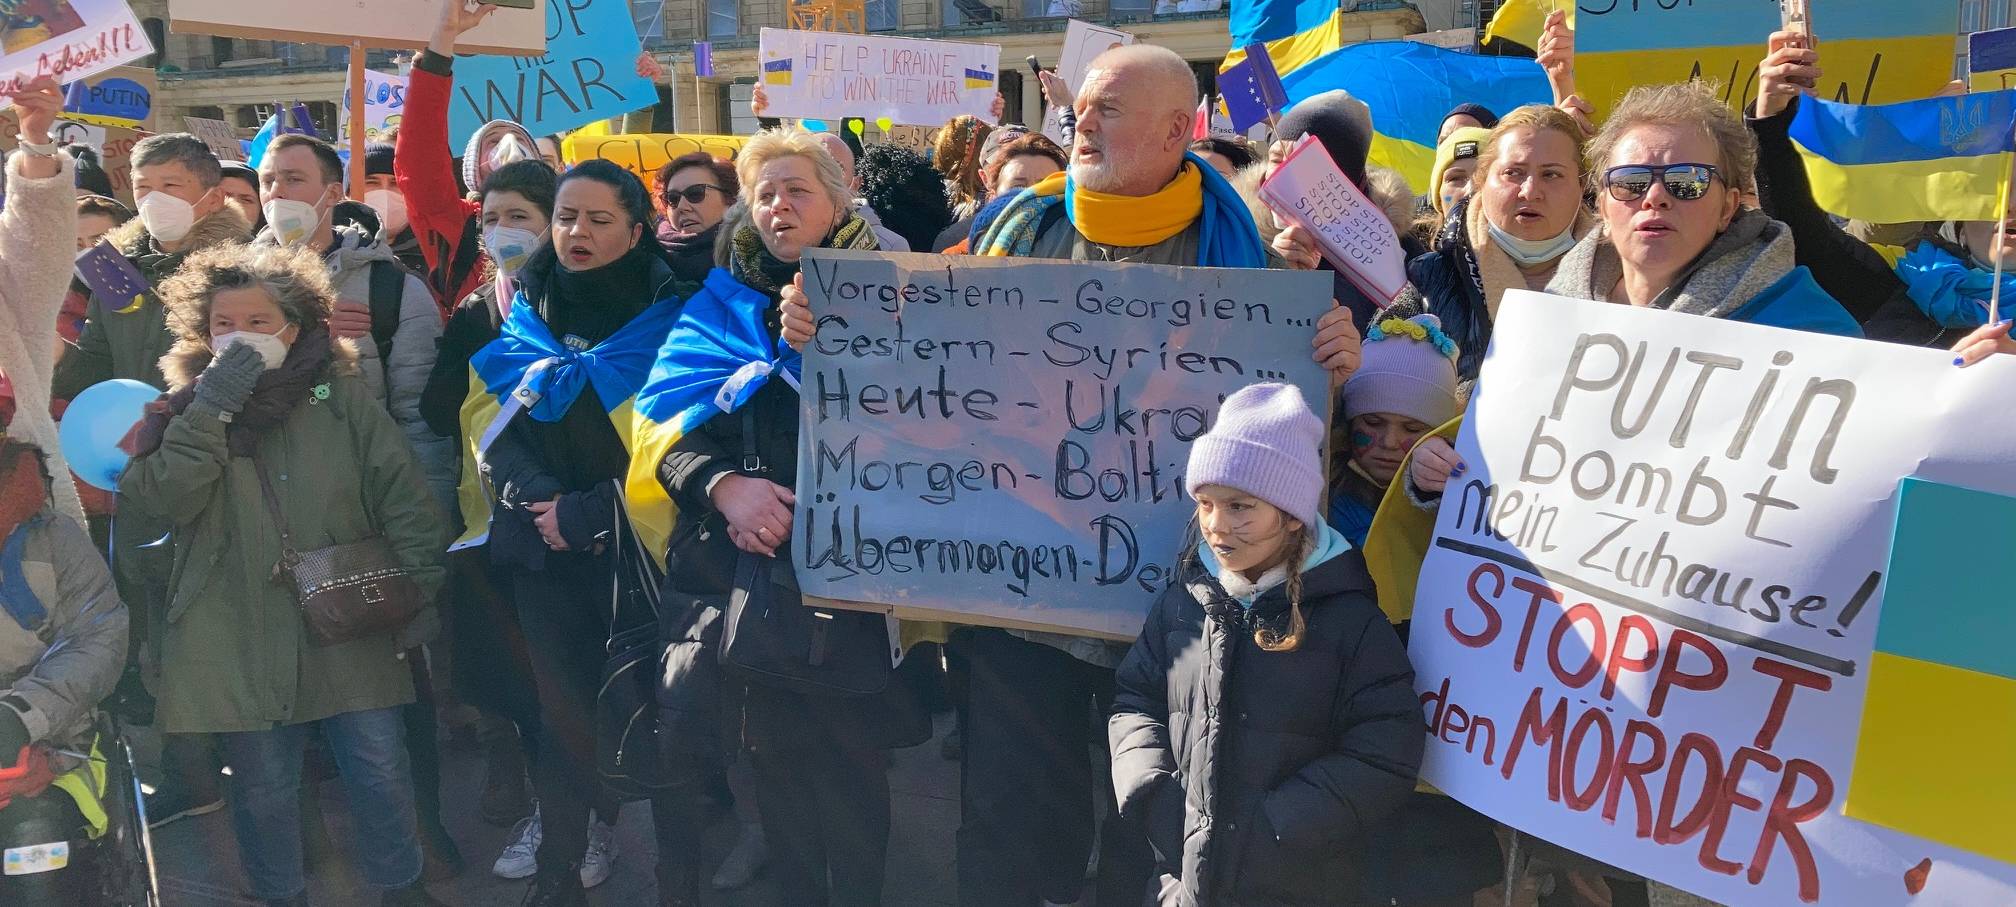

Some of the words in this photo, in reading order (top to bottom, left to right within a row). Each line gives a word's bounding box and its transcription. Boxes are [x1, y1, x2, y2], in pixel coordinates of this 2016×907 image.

[805, 43, 868, 72] HELP
[807, 74, 834, 99] TO
[884, 78, 920, 104] THE
[927, 78, 960, 105] WAR
[90, 86, 151, 110] PUTIN
[459, 58, 628, 125] WAR
[597, 138, 743, 172] CLOS
[1309, 188, 1341, 225] STOP
[1344, 226, 1382, 256] STOP
[1317, 181, 1351, 217] STOP
[1351, 218, 1391, 248] STOP
[1326, 173, 1360, 208] STOP
[1295, 196, 1332, 233] STOP
[1333, 234, 1373, 264] STOP
[812, 258, 1026, 312] Vorgestern
[814, 312, 995, 362] Gestern
[816, 365, 999, 423] Heute
[1065, 379, 1226, 443] Ukra
[1054, 439, 1183, 501] Balti
[1519, 416, 1800, 548] bombt
[1456, 479, 1559, 553] mein
[1578, 511, 1882, 638] Zuhause!
[1445, 562, 1833, 751] STOPPT
[1419, 675, 1495, 766] den
[1500, 685, 1836, 904] MÖRDER
